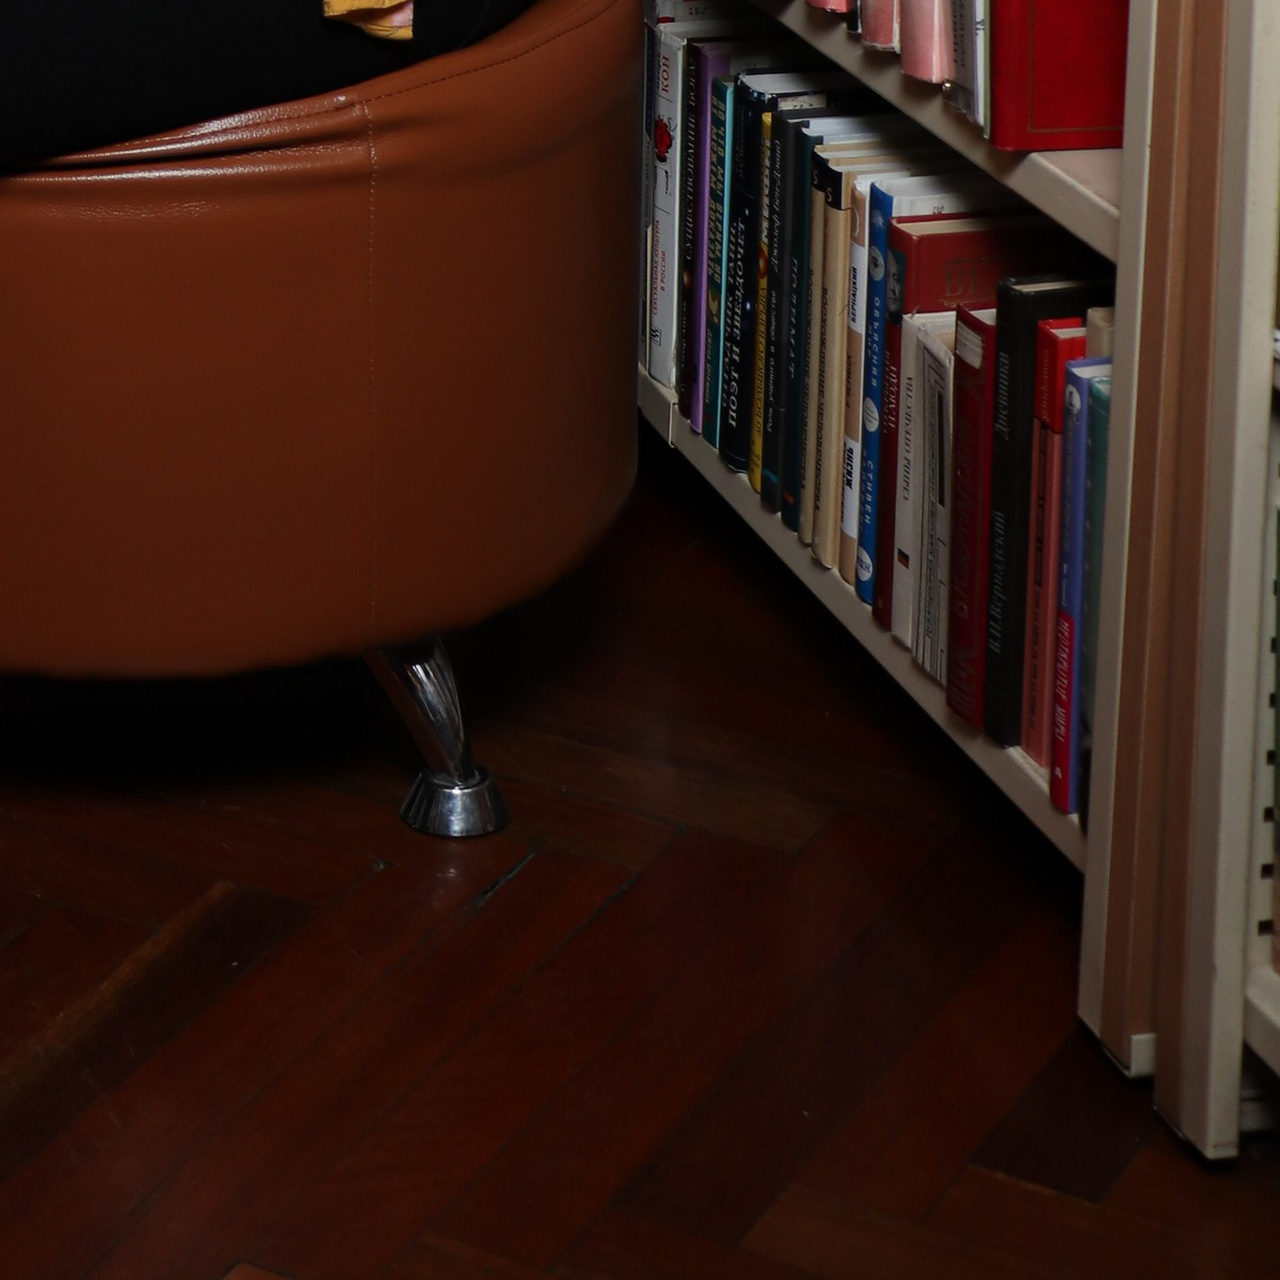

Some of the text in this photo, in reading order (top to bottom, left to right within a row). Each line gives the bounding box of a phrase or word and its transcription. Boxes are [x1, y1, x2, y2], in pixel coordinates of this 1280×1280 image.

[661, 55, 671, 94] КОН
[729, 219, 746, 427] ПОЭТ И ЗВЕЗДОЧЕТ
[994, 351, 1010, 439] Дневники
[864, 460, 873, 524] СТИВЕН
